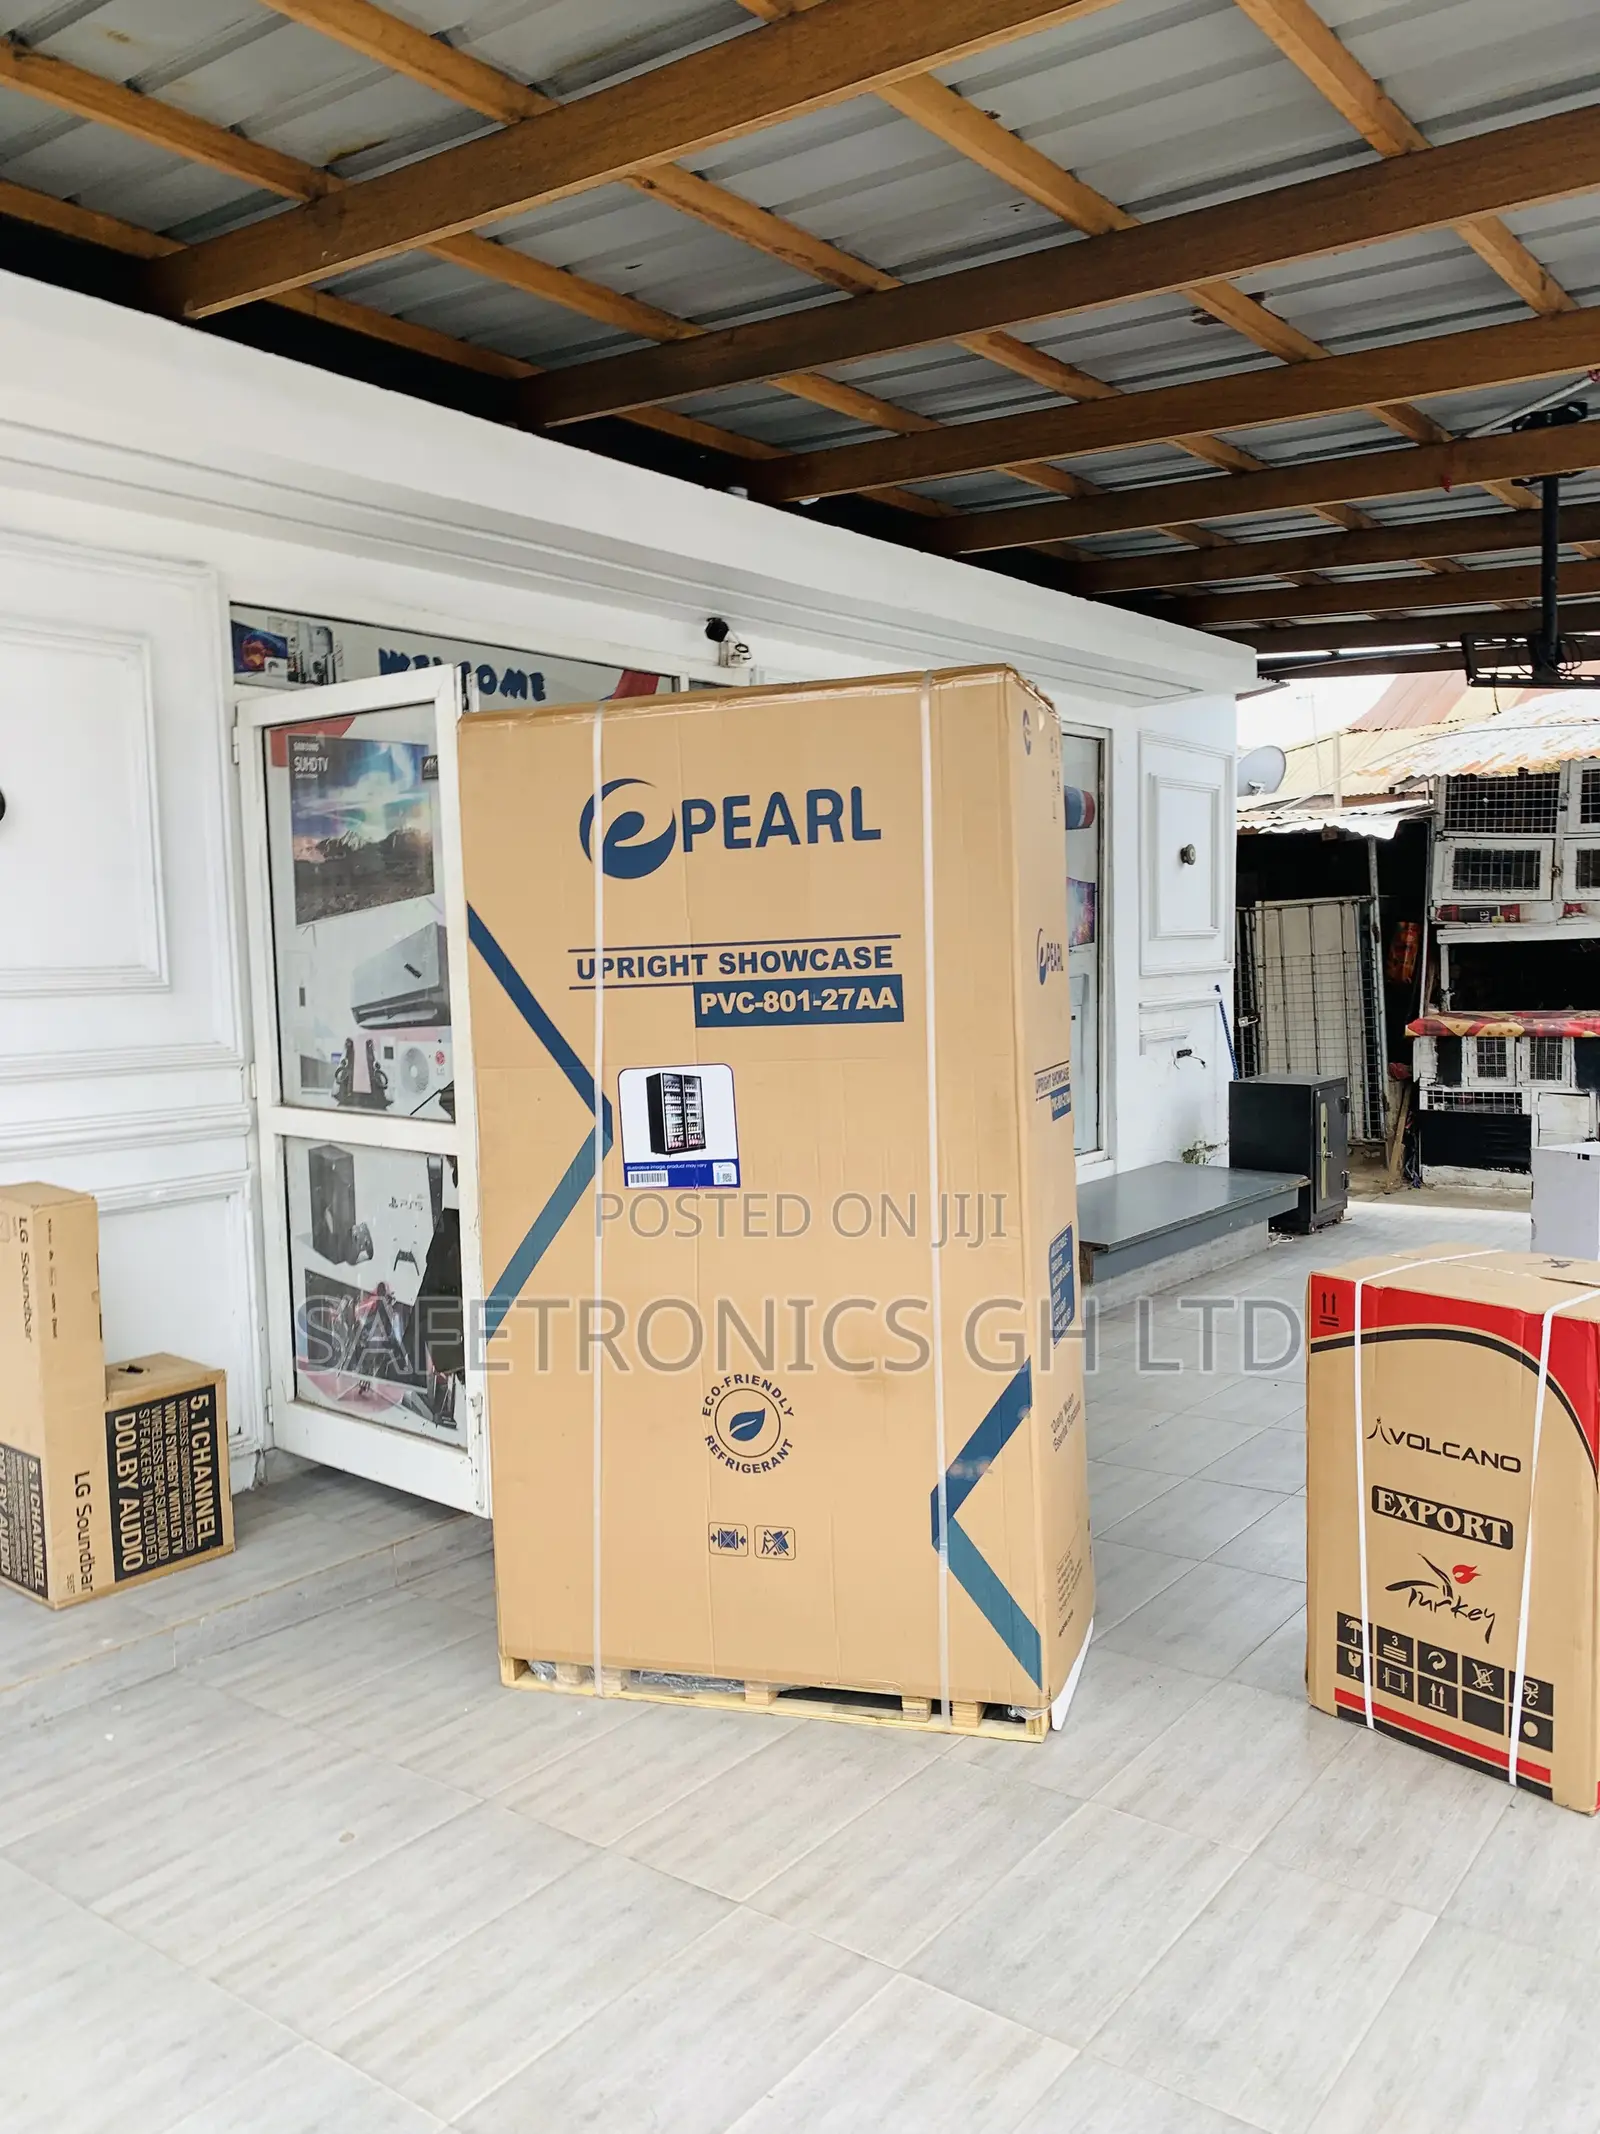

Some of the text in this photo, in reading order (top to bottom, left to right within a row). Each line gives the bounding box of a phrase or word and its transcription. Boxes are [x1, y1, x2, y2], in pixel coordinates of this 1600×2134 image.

[378, 647, 546, 702] WOME
[681, 785, 882, 853] PEARL
[575, 945, 894, 981] UPRIGHT SHOWCASE
[699, 986, 898, 1016] PVC-801-27AA
[18, 1217, 33, 1343] LG Soundbar
[701, 1373, 795, 1418] ECO-FRIENDLY
[151, 1405, 169, 1560] WIRELESS REAR SURROUND
[164, 1401, 183, 1554] WOW SYNERGY WITH LG TV
[704, 1435, 794, 1474] REFRIGERANT
[1389, 1427, 1522, 1474] VOLCANO
[114, 1411, 144, 1572] DOLBY AUDIO
[138, 1408, 158, 1565] SPEAKERS INCLUDED
[1375, 1488, 1510, 1548] EXPORT
[74, 1470, 96, 1592] LG Soundbar
[1385, 1570, 1497, 1645] Turkey
[1391, 1634, 1400, 1647] 3
